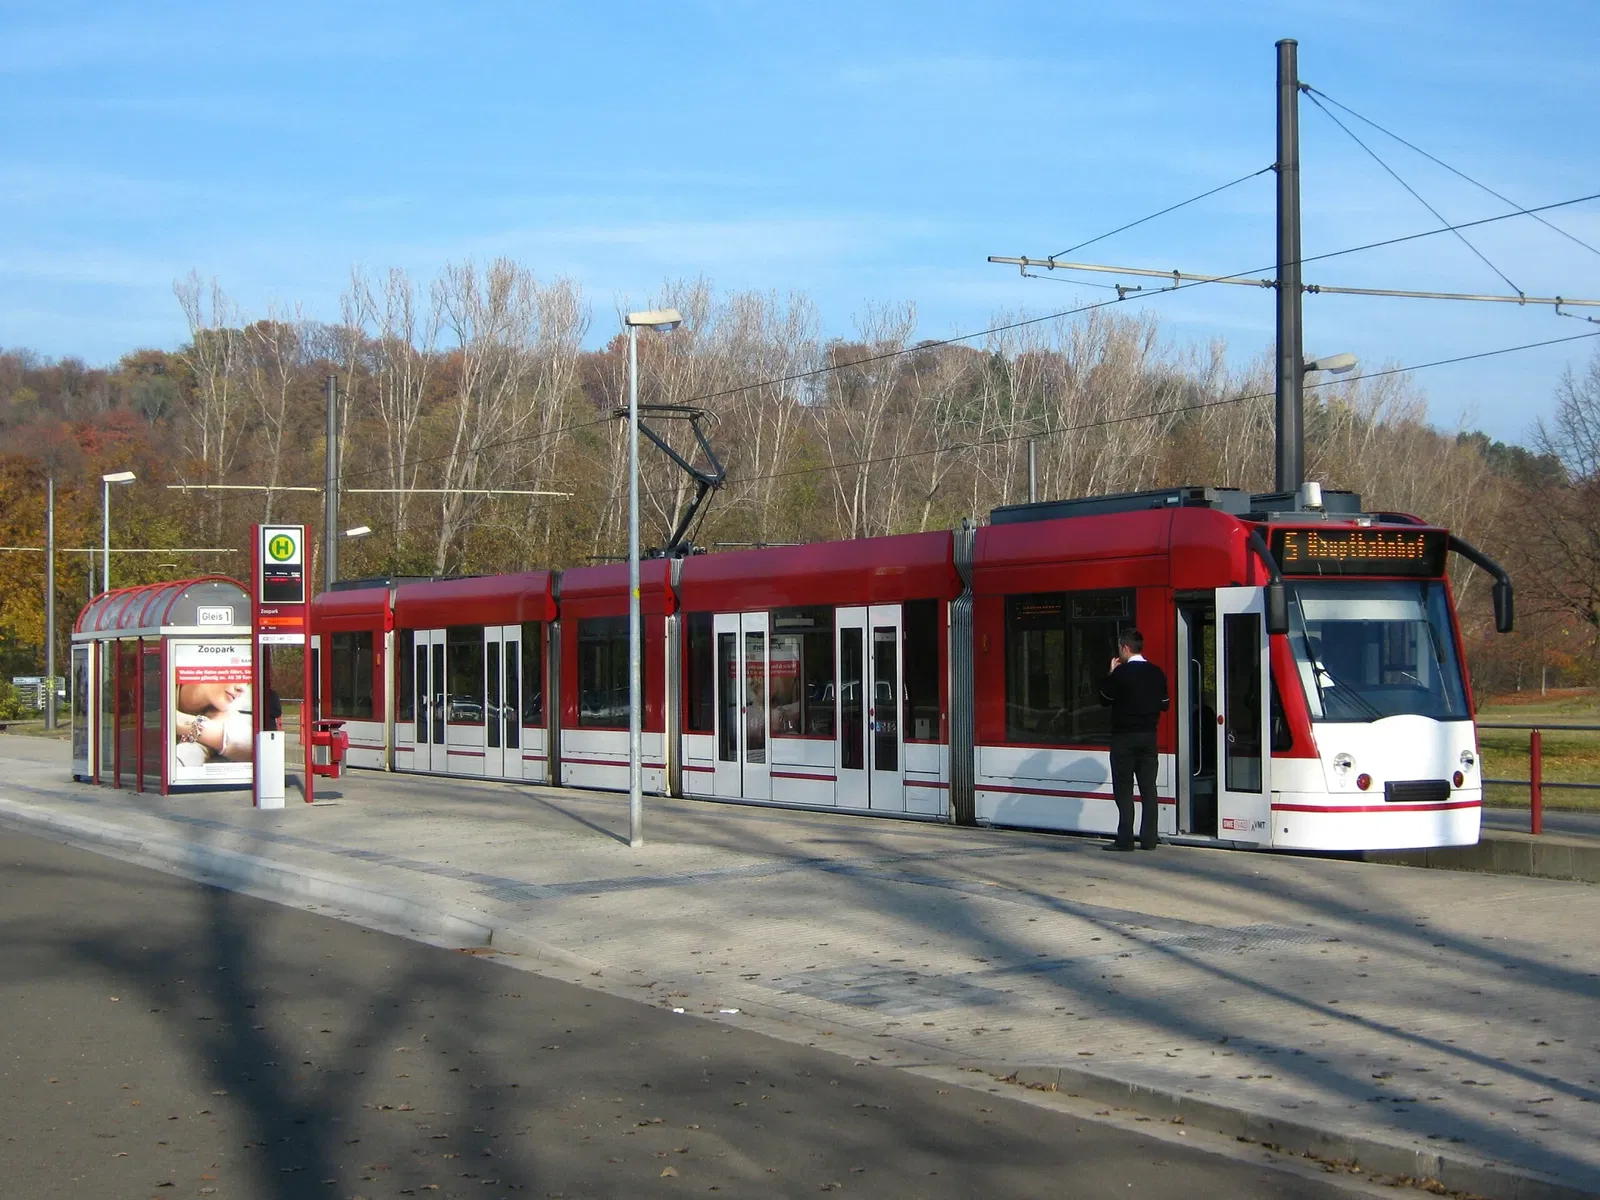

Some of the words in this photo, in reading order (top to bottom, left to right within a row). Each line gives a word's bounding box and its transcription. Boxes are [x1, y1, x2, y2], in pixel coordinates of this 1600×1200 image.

[276, 541, 288, 555] H
[1285, 532, 1298, 560] 5
[1308, 532, 1424, 560] Hauptbahnhof
[202, 611, 223, 621] Gleis
[225, 611, 230, 622] 1
[198, 645, 235, 654] Zoopark
